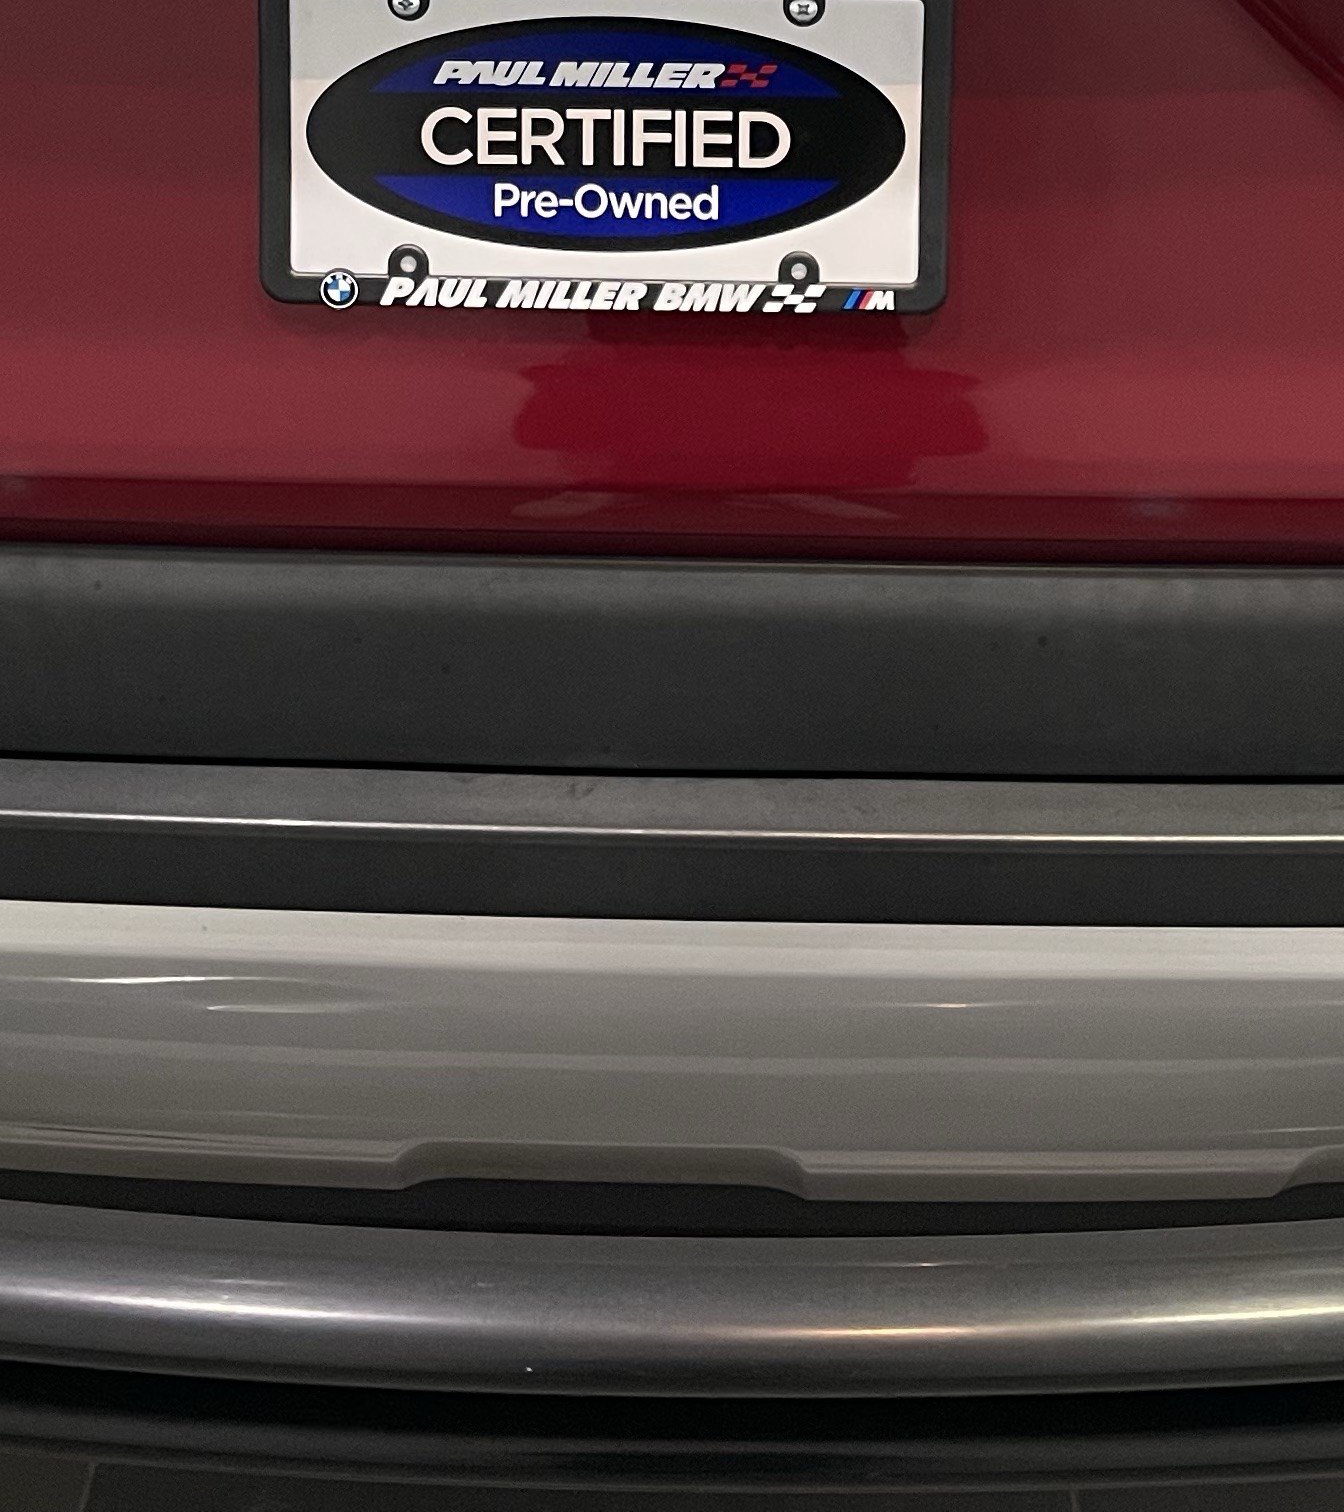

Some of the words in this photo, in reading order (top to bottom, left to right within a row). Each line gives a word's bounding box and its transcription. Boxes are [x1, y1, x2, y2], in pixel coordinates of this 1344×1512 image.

[433, 60, 548, 87] PAUL
[549, 61, 726, 89] MILLER
[420, 106, 792, 169] CERTIFIED
[494, 182, 719, 221] Pre-Owned
[379, 276, 488, 308] PAUL
[494, 279, 648, 311] MILLER
[652, 282, 767, 313] BMW
